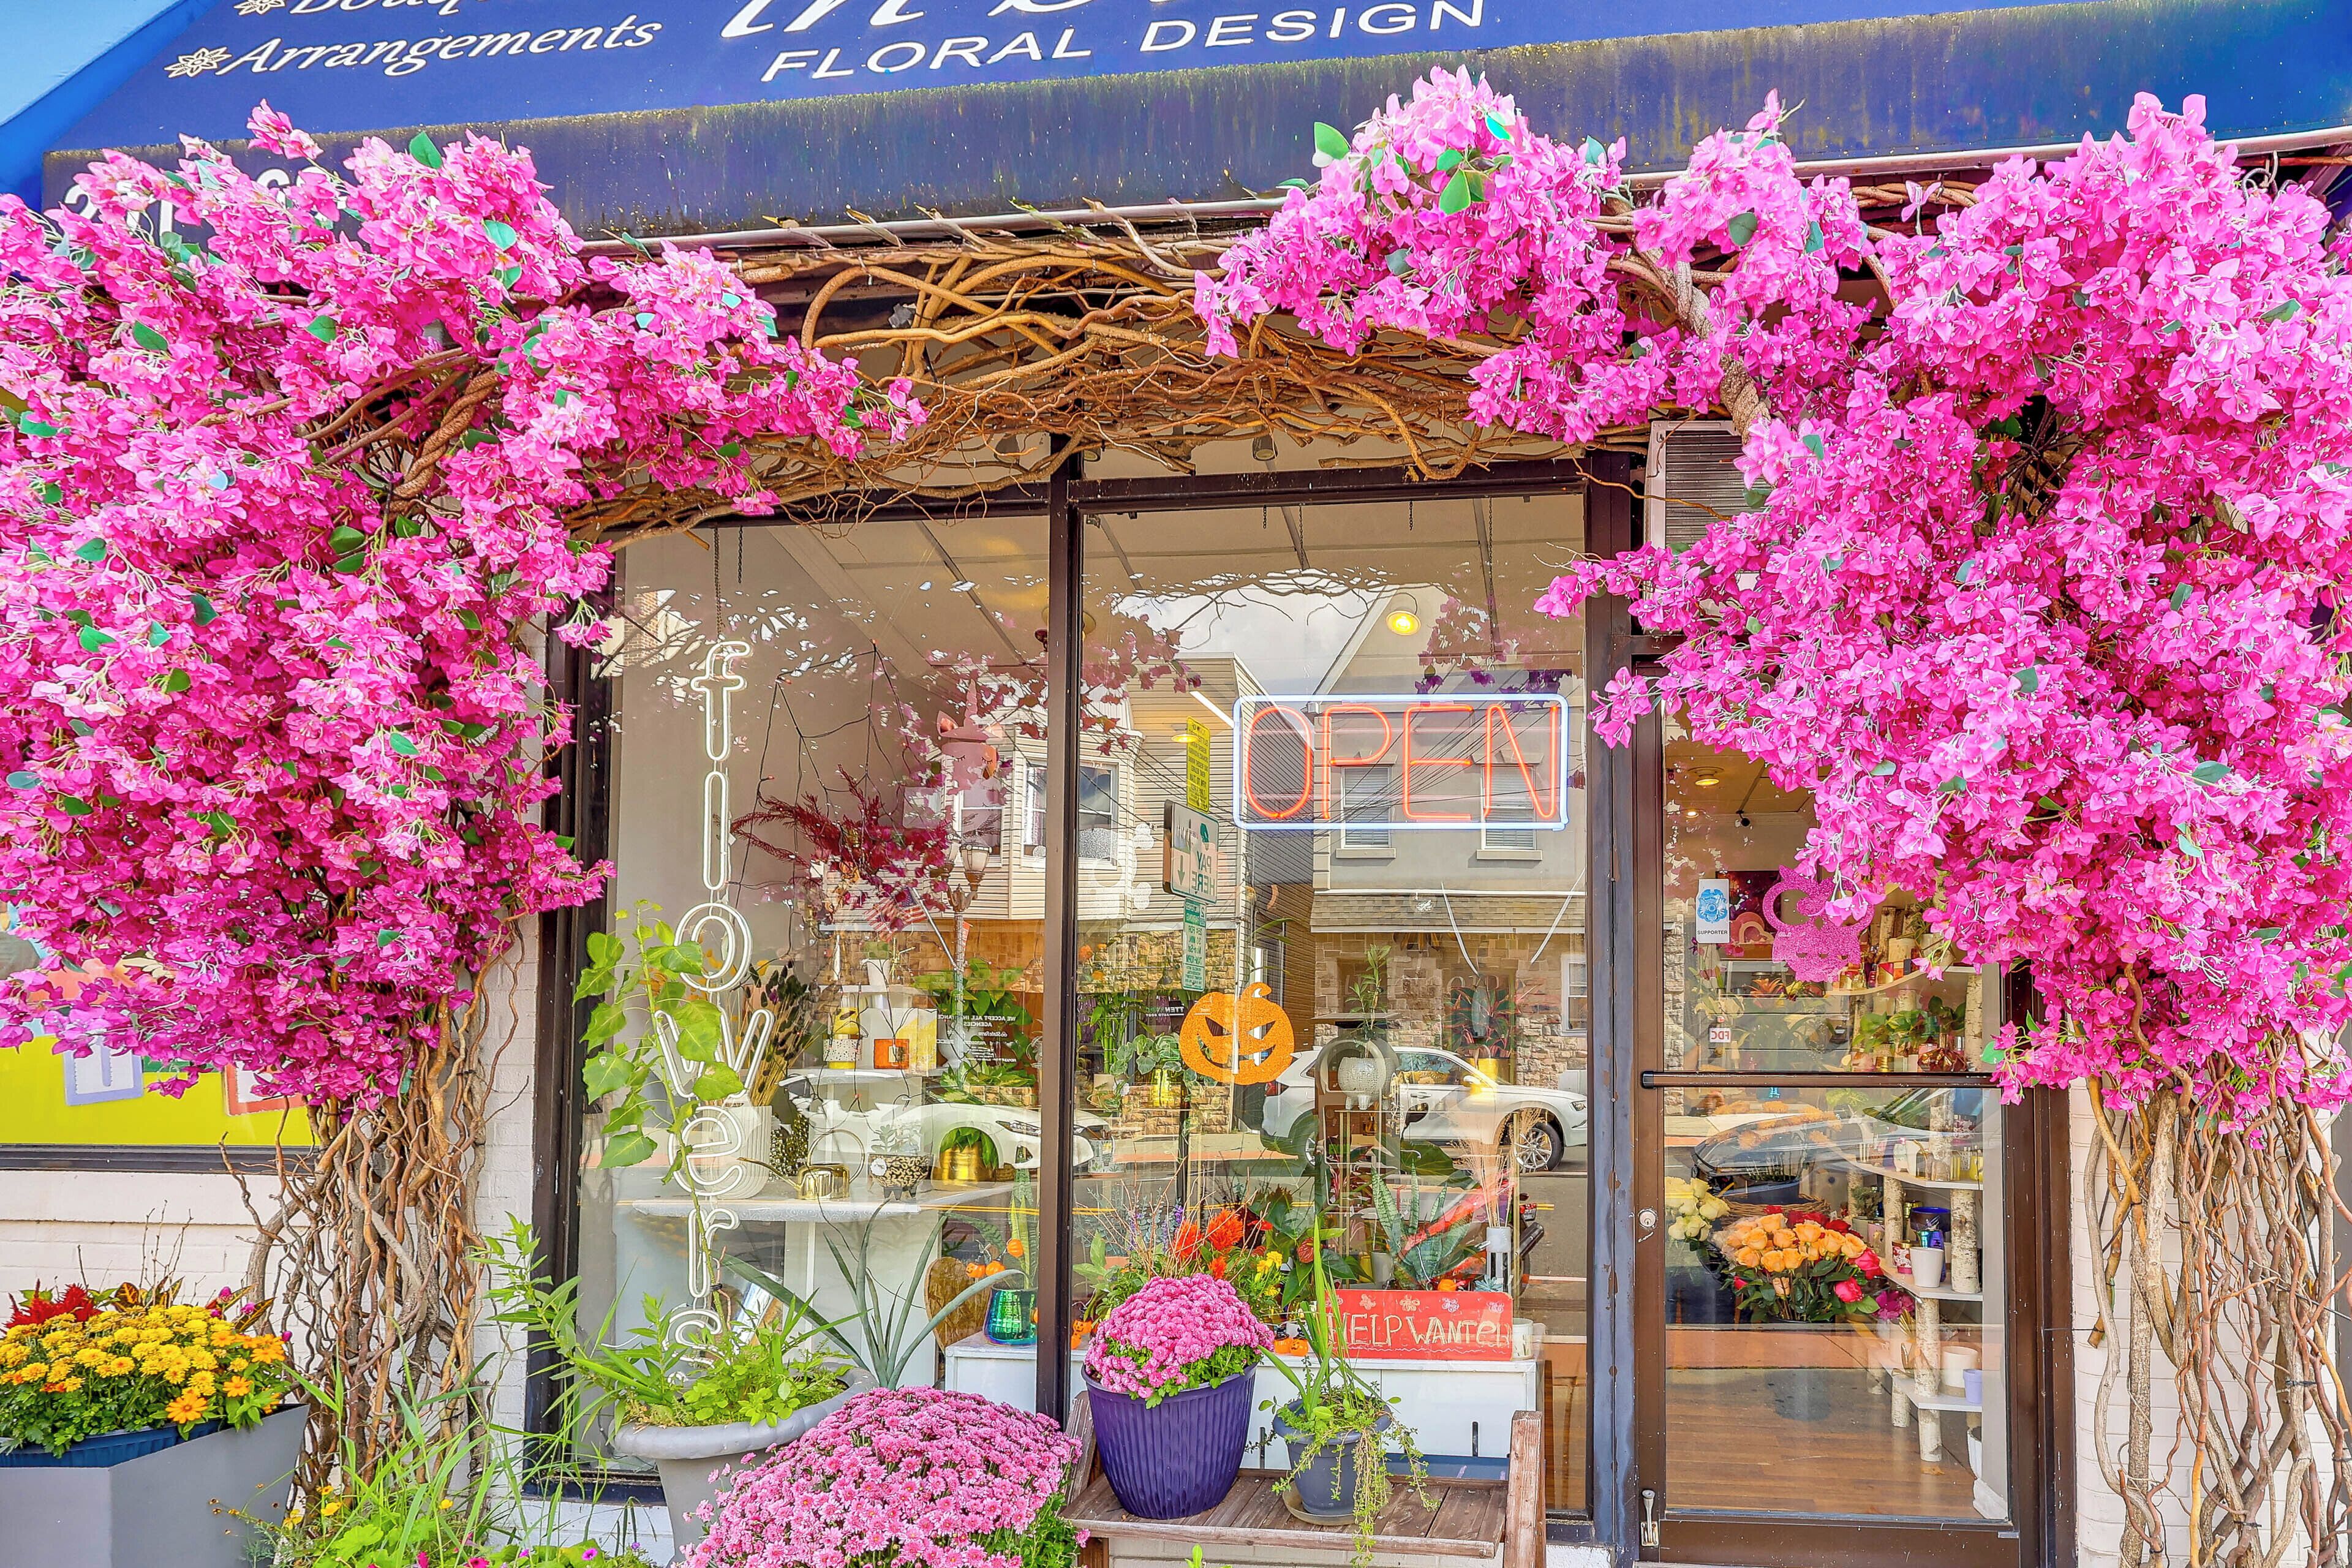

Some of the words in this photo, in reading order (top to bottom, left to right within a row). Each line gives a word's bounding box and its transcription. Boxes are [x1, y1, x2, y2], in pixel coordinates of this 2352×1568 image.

[216, 14, 662, 76] Arrangements
[760, 28, 1091, 82] FLORAL
[1140, 0, 1484, 51] DESIGN
[1244, 704, 1558, 820] OPEN
[1325, 1312, 1403, 1347] HELP
